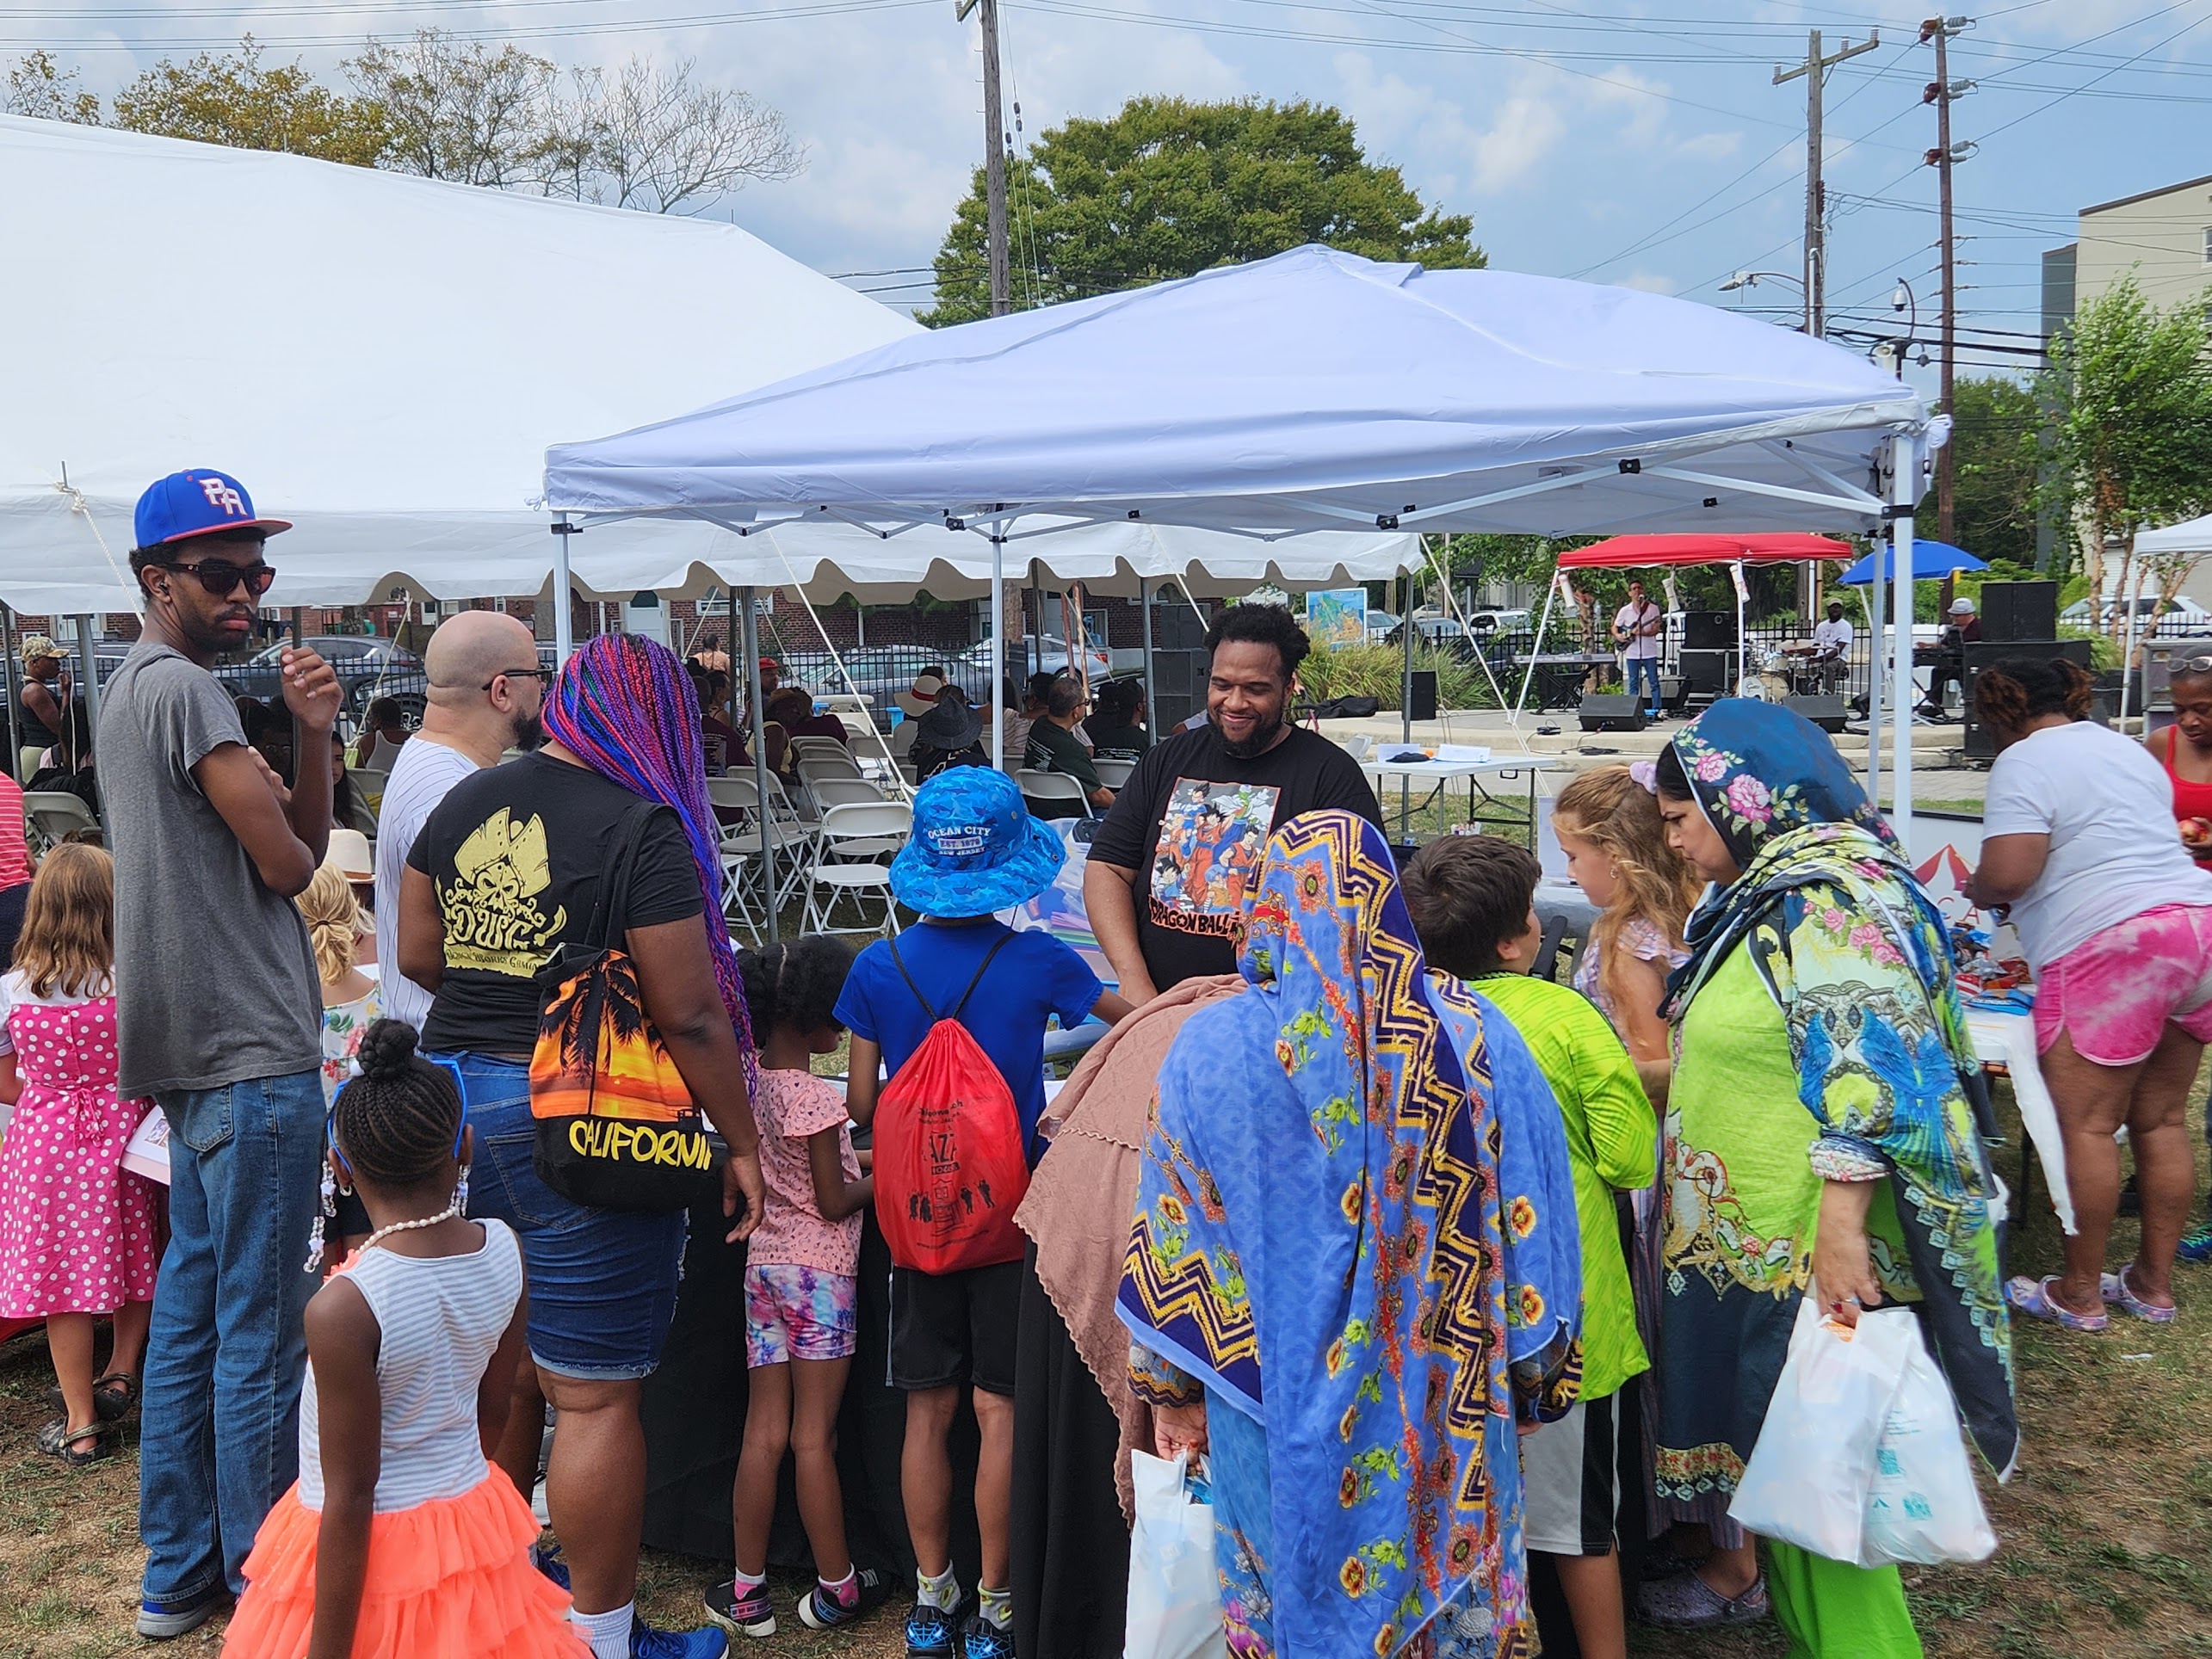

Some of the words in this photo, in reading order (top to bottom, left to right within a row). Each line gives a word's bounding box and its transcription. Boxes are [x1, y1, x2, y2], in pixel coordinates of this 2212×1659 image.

[928, 826, 961, 839] OCEAN
[964, 826, 992, 836] CITY
[956, 846, 985, 856] JERSEY
[510, 956, 540, 971] GAMIN
